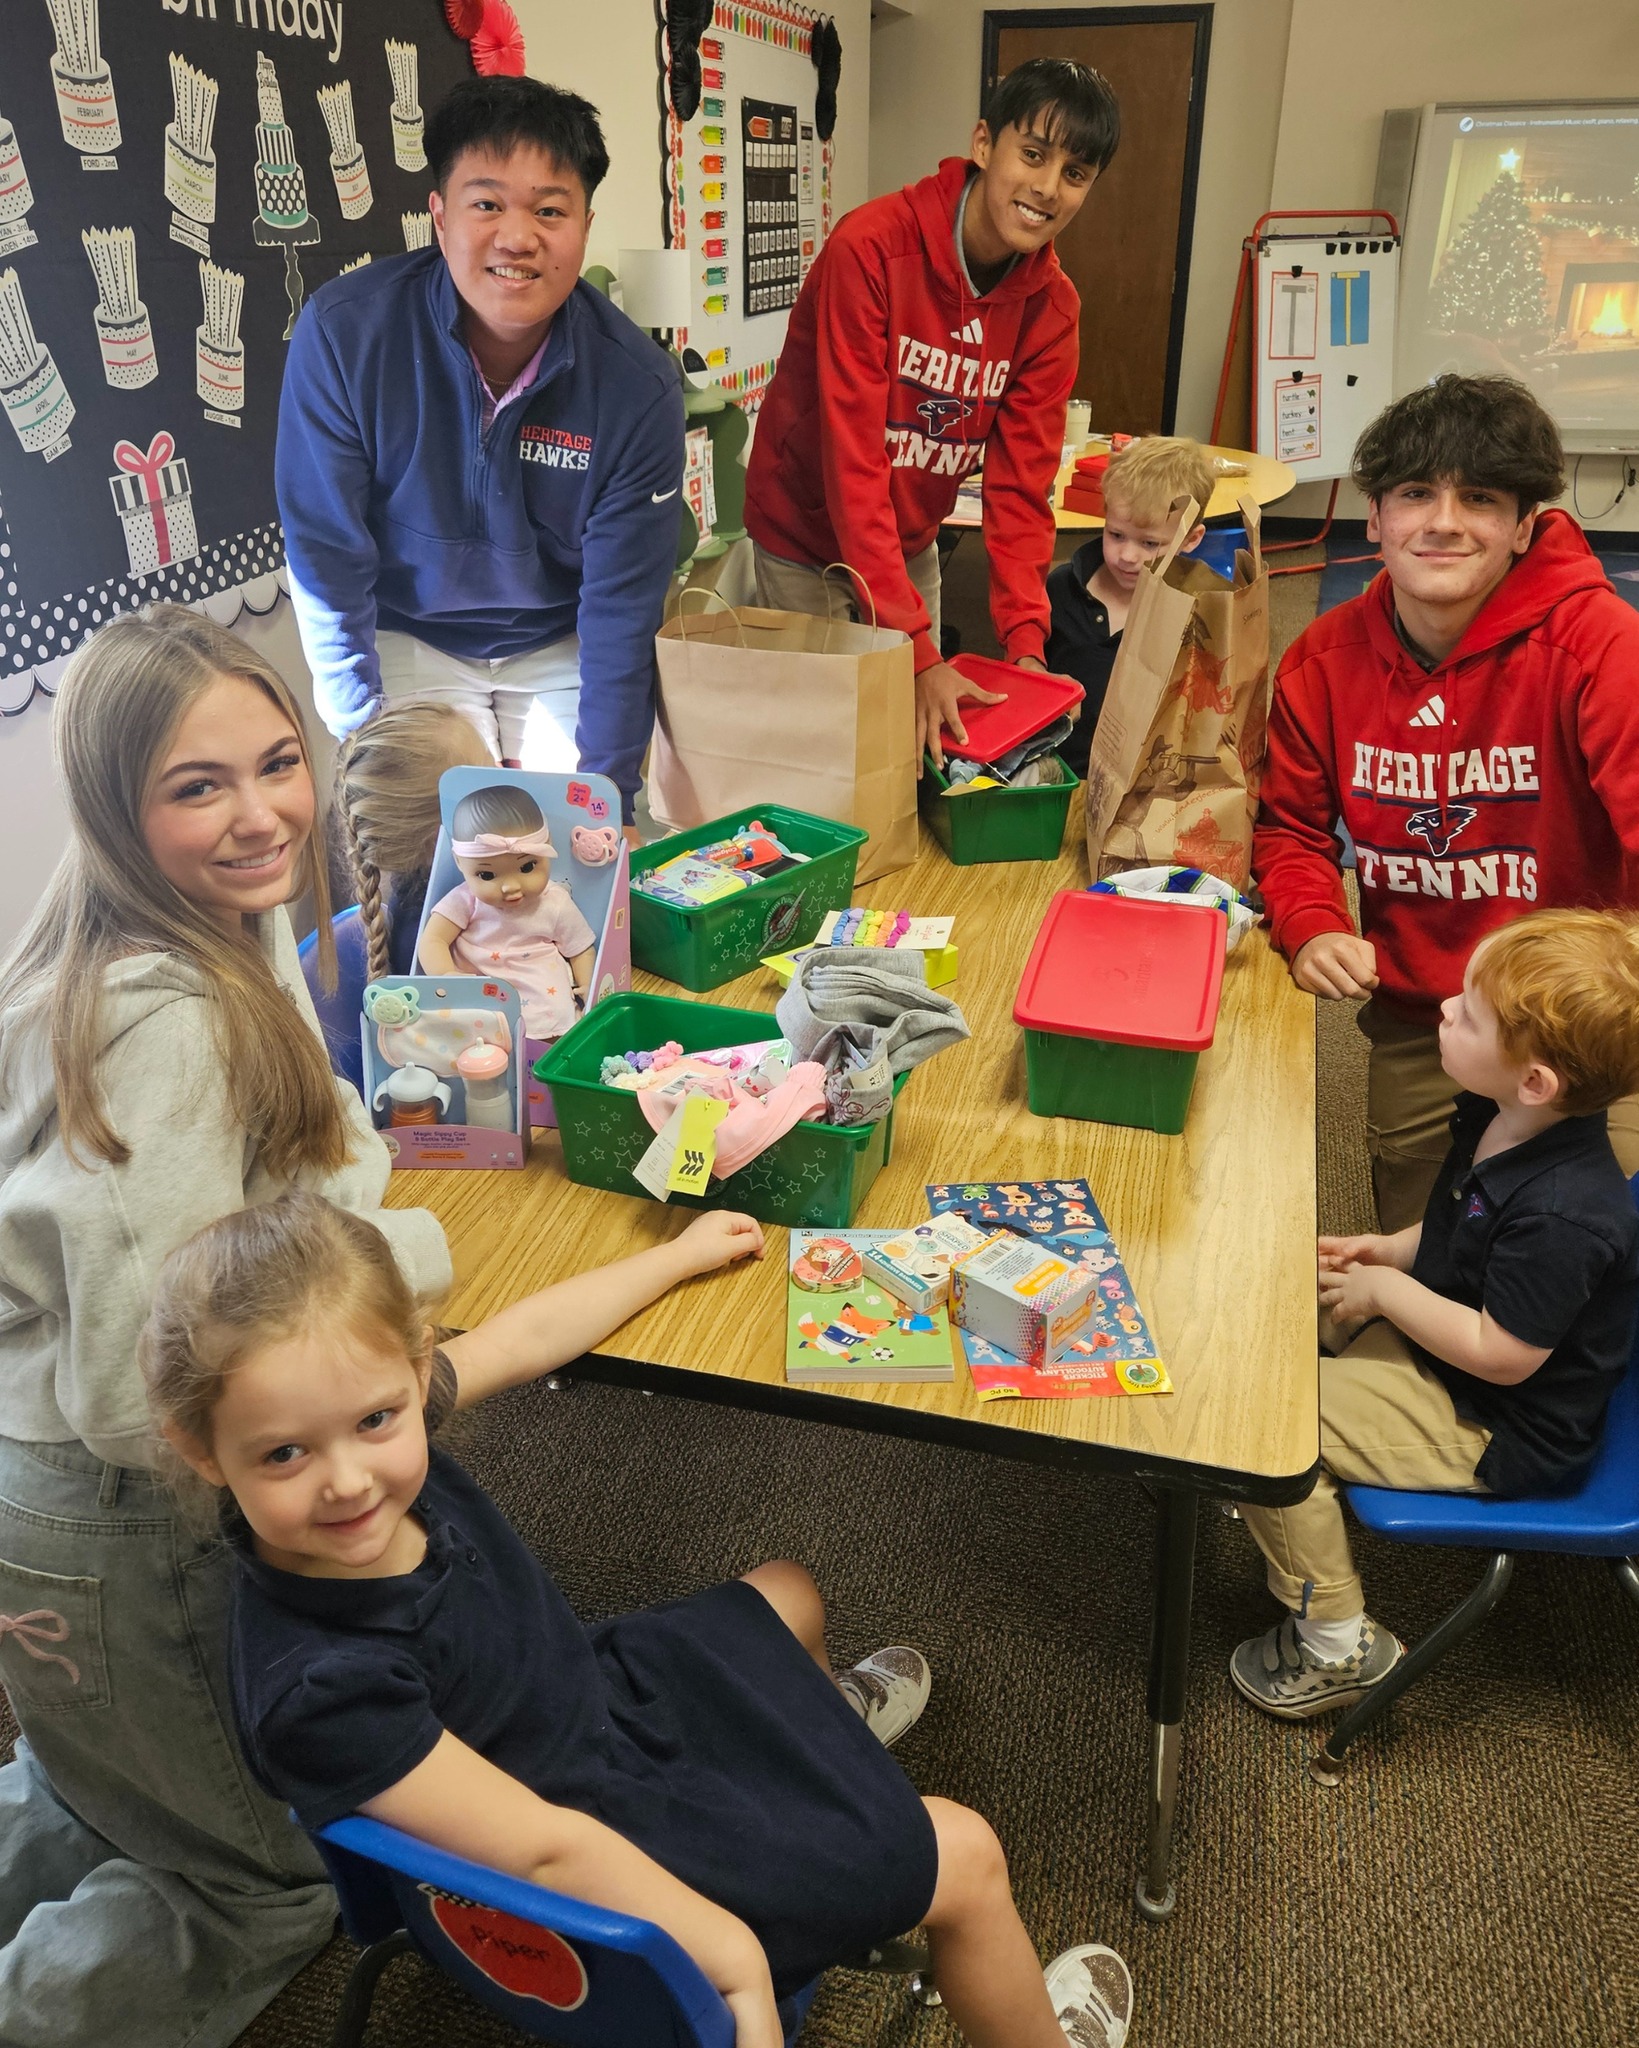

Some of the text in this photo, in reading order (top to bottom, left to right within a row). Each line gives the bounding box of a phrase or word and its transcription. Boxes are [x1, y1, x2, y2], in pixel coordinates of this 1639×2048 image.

[77, 106, 104, 118] FEBRUARY
[83, 159, 100, 168] FORD
[104, 159, 116, 168] 2nd
[184, 177, 203, 193] MARCH
[17, 222, 28, 233] 3rd
[173, 213, 196, 232] LUCILLE
[0, 241, 19, 255] ADEN
[22, 235, 37, 245] 14th
[171, 229, 195, 247] CANNON
[126, 349, 137, 358] MAY
[218, 373, 229, 382] JUNE
[35, 398, 50, 415] APRIL
[206, 411, 224, 422] AUGGIE
[521, 425, 592, 451] HERITAGE
[45, 446, 59, 461] SAM
[519, 440, 590, 470] HAWKS
[1352, 741, 1540, 800] HERITAGE
[709, 846, 738, 859] Colgate
[1355, 844, 1538, 902] TENNIS
[868, 1250, 882, 1261] 14
[880, 1258, 900, 1275] ADHESIVE
[897, 1270, 924, 1291] BANDAGES
[1035, 1366, 1105, 1377] AUTOCOLLANTS
[1064, 1372, 1108, 1381] STICKERS
[468, 1922, 550, 1962] Piper
